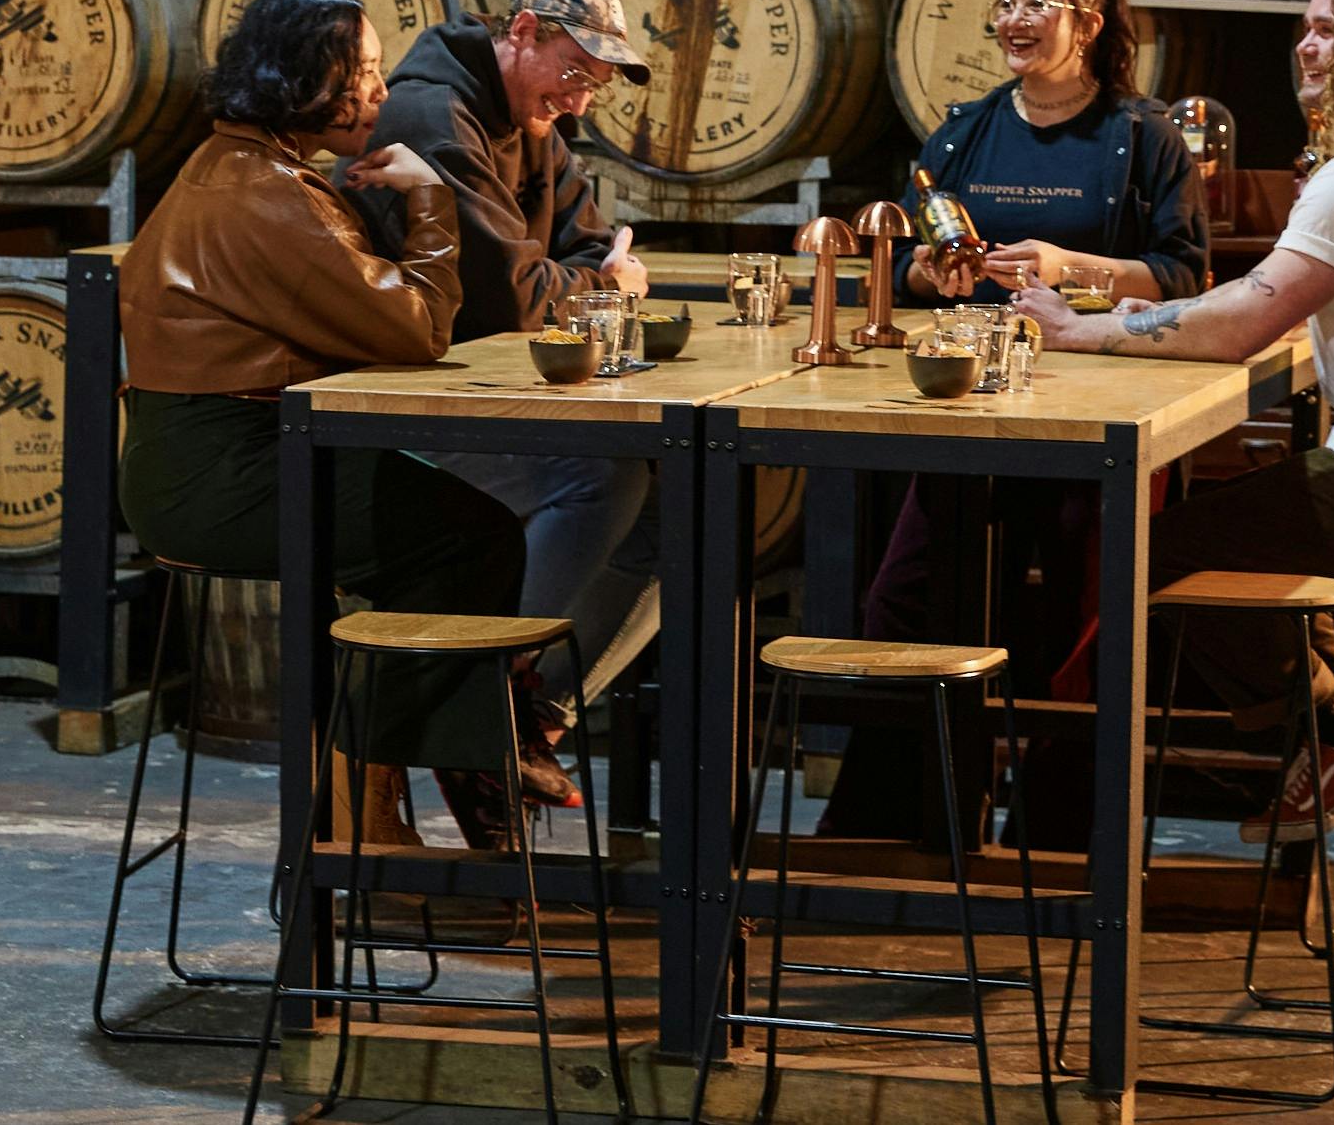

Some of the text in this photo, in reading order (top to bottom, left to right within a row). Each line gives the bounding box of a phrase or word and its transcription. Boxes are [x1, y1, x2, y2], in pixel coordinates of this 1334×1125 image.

[969, 183, 1084, 198] WHIPPER SNAPPER
[995, 196, 1048, 205] DISTILLERY
